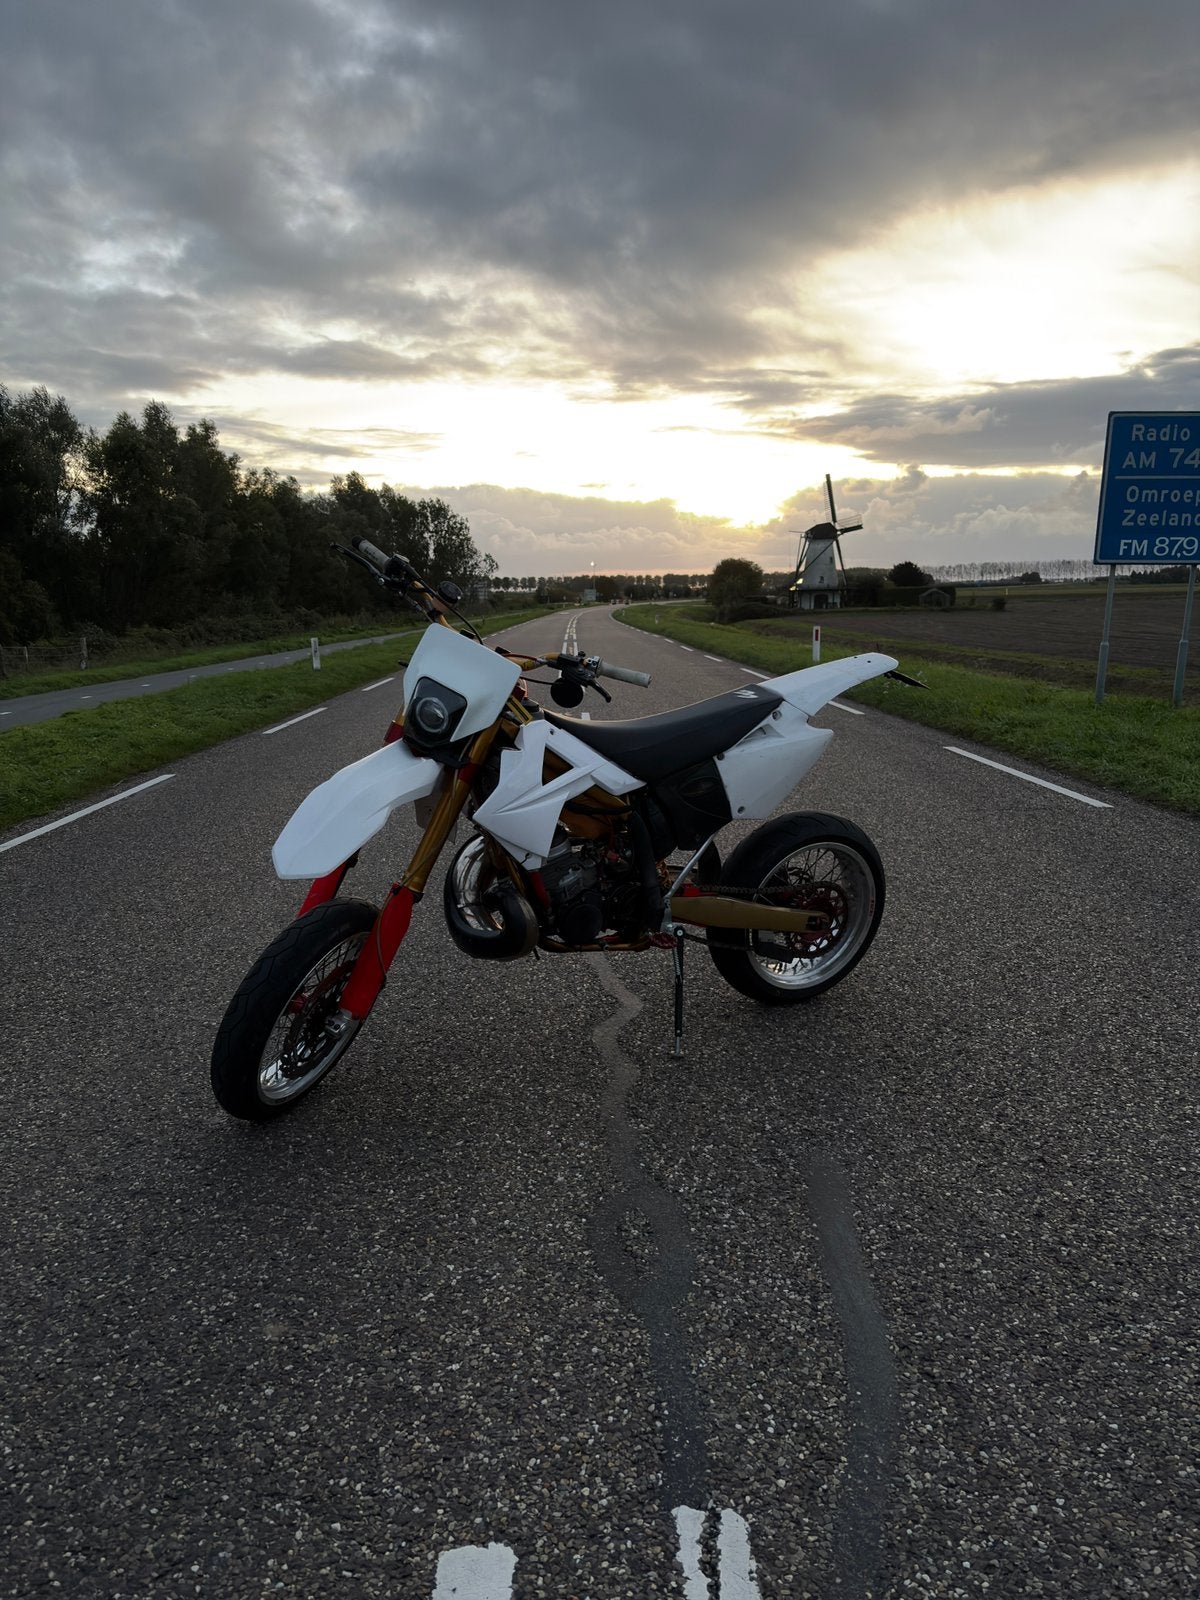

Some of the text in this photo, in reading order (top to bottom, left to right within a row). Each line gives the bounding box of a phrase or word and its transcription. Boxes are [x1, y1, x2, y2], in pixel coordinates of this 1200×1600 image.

[1131, 424, 1191, 442] Radio
[1122, 451, 1157, 469] AM
[1119, 536, 1199, 559] FM 87,9
